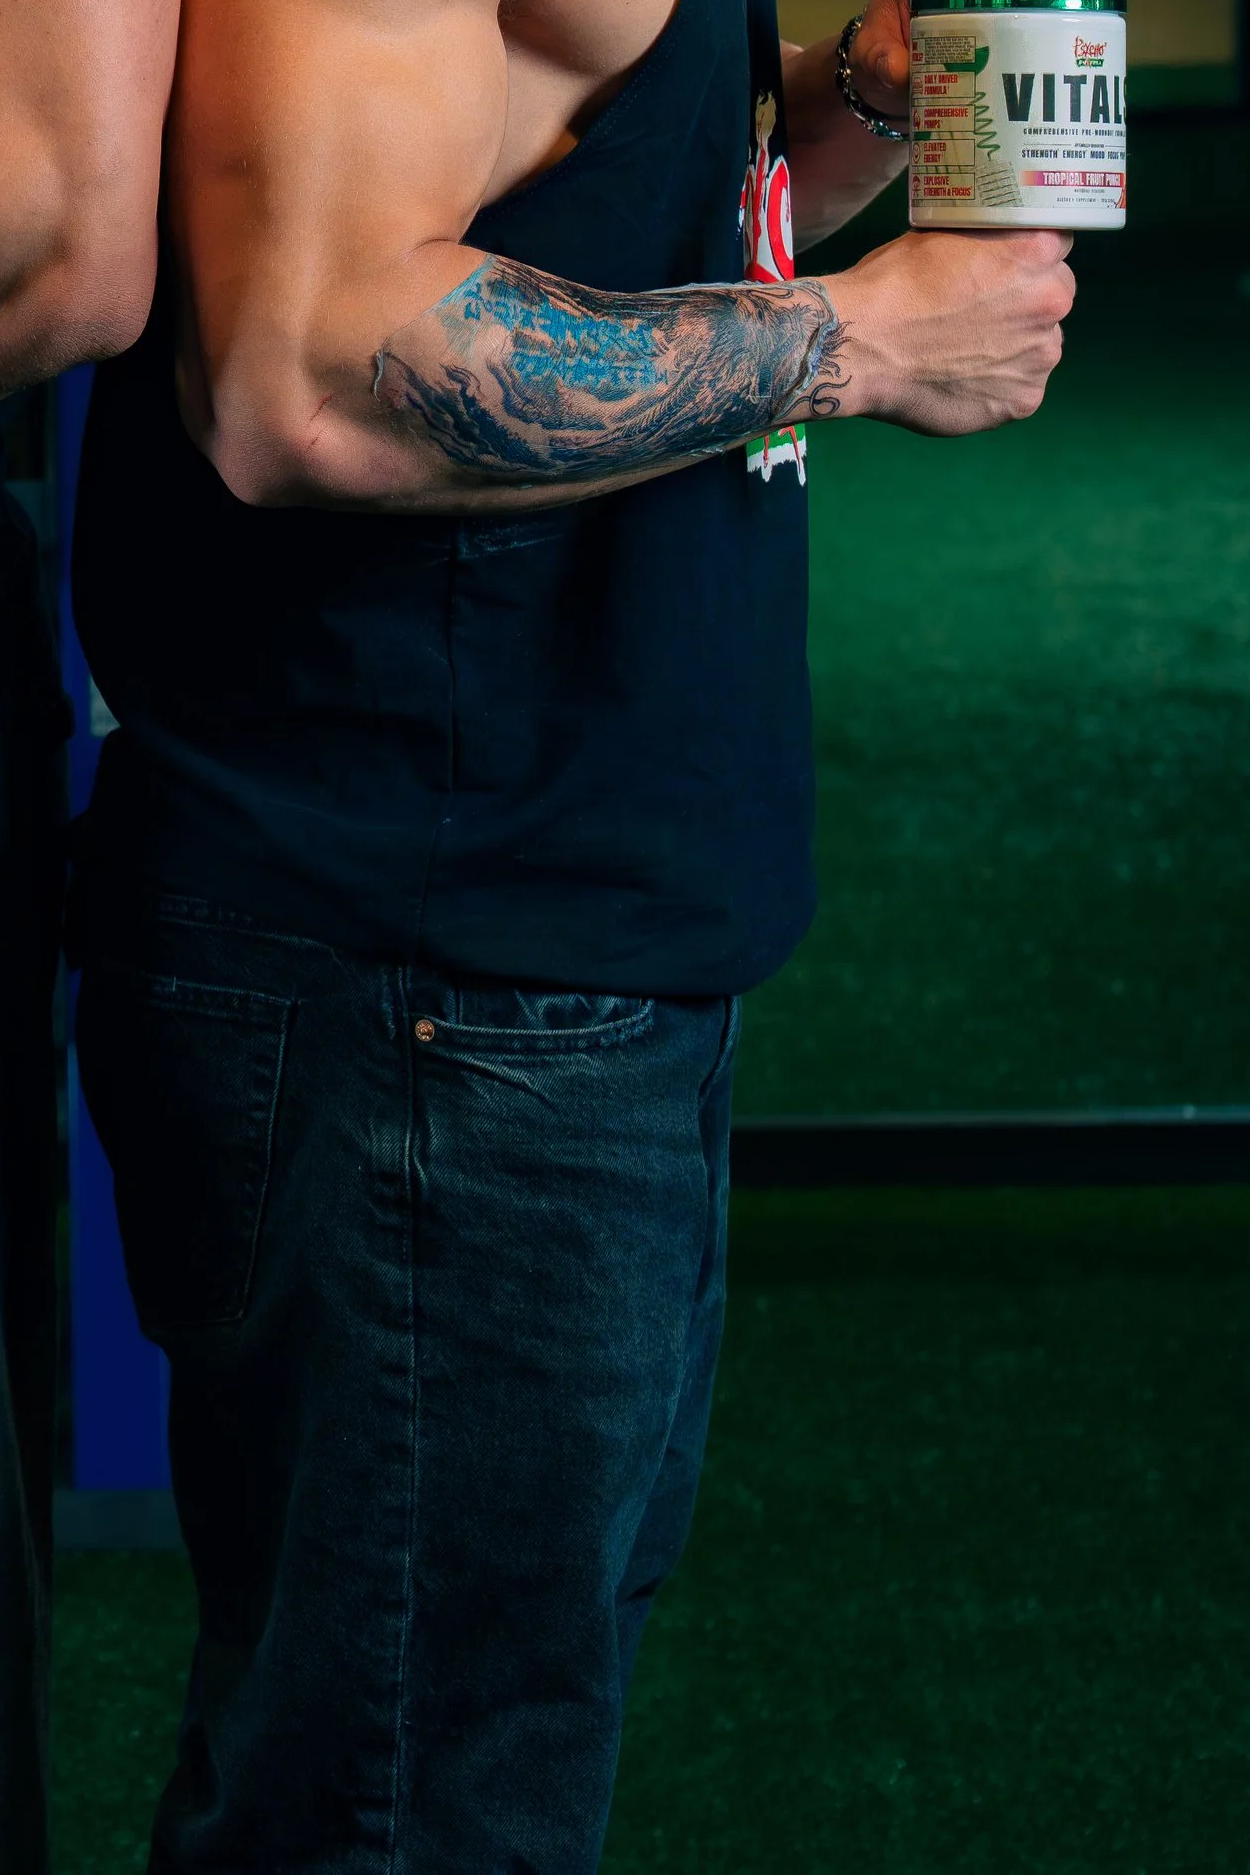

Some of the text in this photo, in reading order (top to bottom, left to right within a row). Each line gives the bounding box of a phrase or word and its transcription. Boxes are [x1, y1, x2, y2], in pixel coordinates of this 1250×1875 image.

[1073, 36, 1104, 58] PSYCHO
[1002, 73, 1127, 124] VITAL
[924, 109, 968, 117] COMPREHENSIVE
[1022, 149, 1058, 158] STRENGTH
[1063, 150, 1086, 158] ENERGY
[1043, 172, 1084, 185] TROPICAL
[1086, 174, 1104, 186] FRUIT
[952, 187, 971, 196] FOCUS
